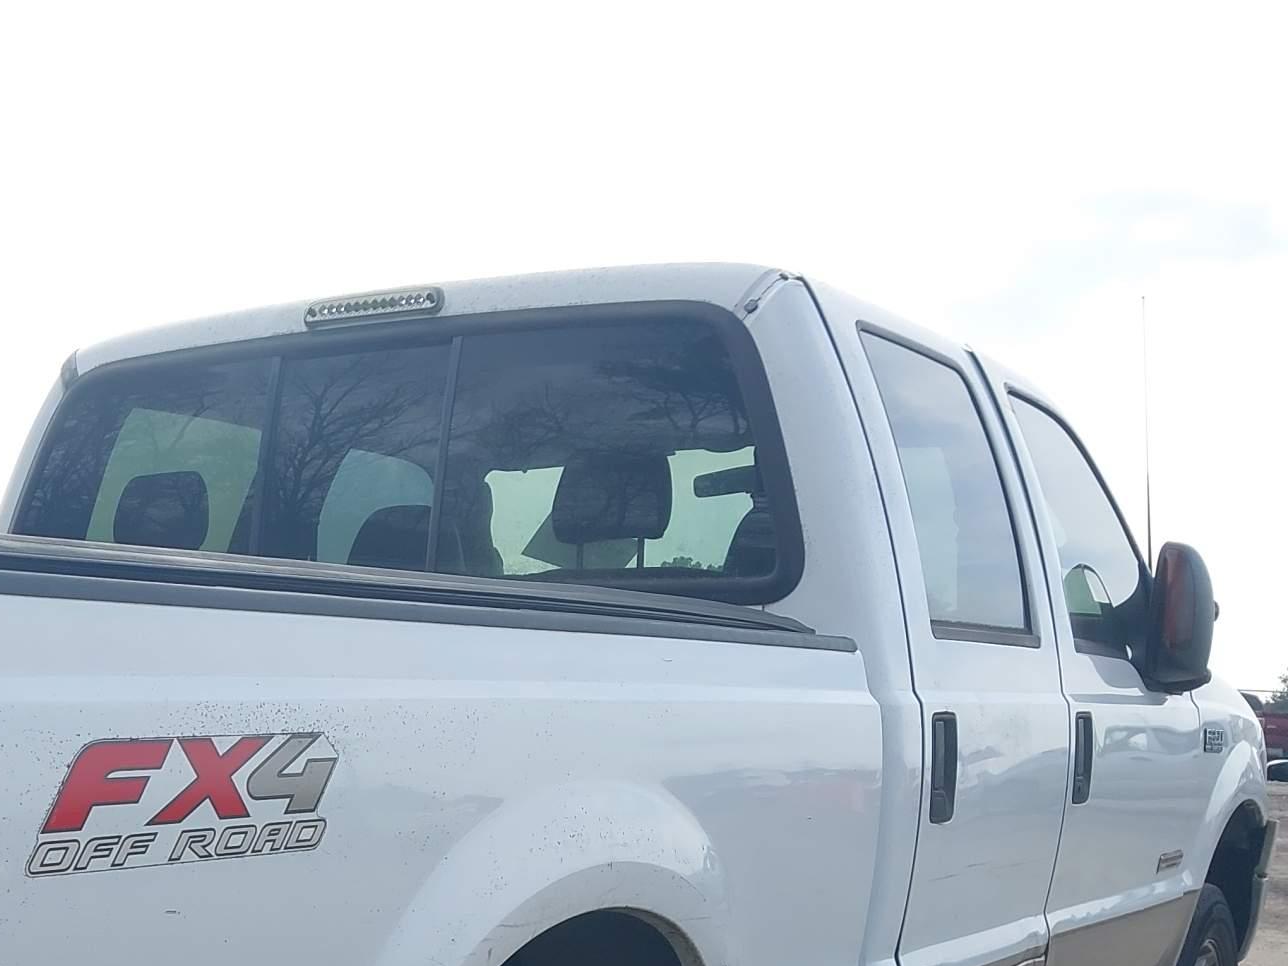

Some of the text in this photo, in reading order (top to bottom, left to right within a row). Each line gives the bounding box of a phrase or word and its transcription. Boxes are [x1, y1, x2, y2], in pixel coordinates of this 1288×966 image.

[39, 733, 339, 834] FX4
[26, 818, 327, 875] OFF ROAD
